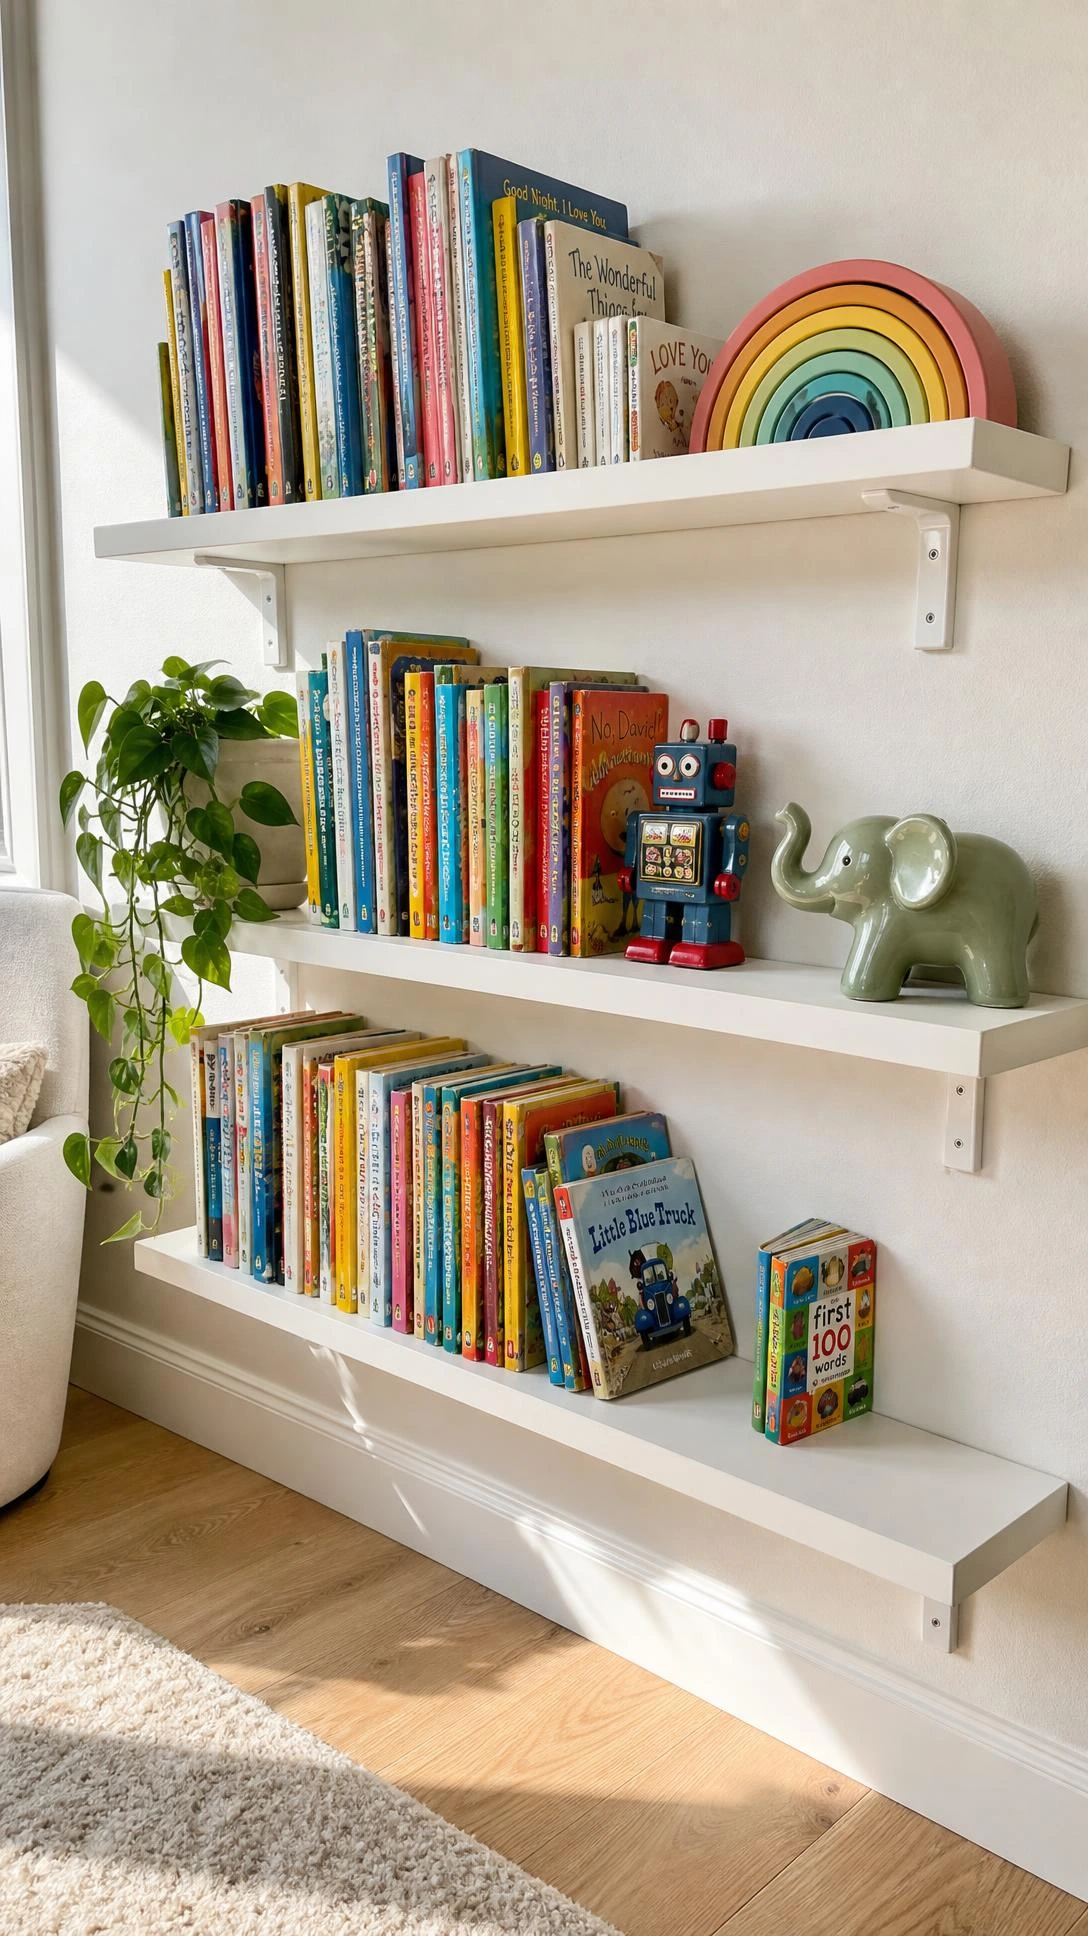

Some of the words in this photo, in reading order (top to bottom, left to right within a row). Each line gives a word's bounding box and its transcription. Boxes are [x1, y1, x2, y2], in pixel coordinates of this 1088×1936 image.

[503, 179, 528, 201] Good
[562, 200, 567, 214] I
[568, 201, 589, 222] Love
[568, 247, 594, 280] The
[593, 255, 656, 301] Wonderful
[650, 341, 686, 375] LOVE
[591, 711, 615, 745] No,
[588, 1217, 627, 1255] Little
[625, 1208, 656, 1234] Blue
[654, 1201, 696, 1226] Truck
[813, 1297, 852, 1330] first
[812, 1323, 852, 1361] 100
[815, 1352, 847, 1375] words
